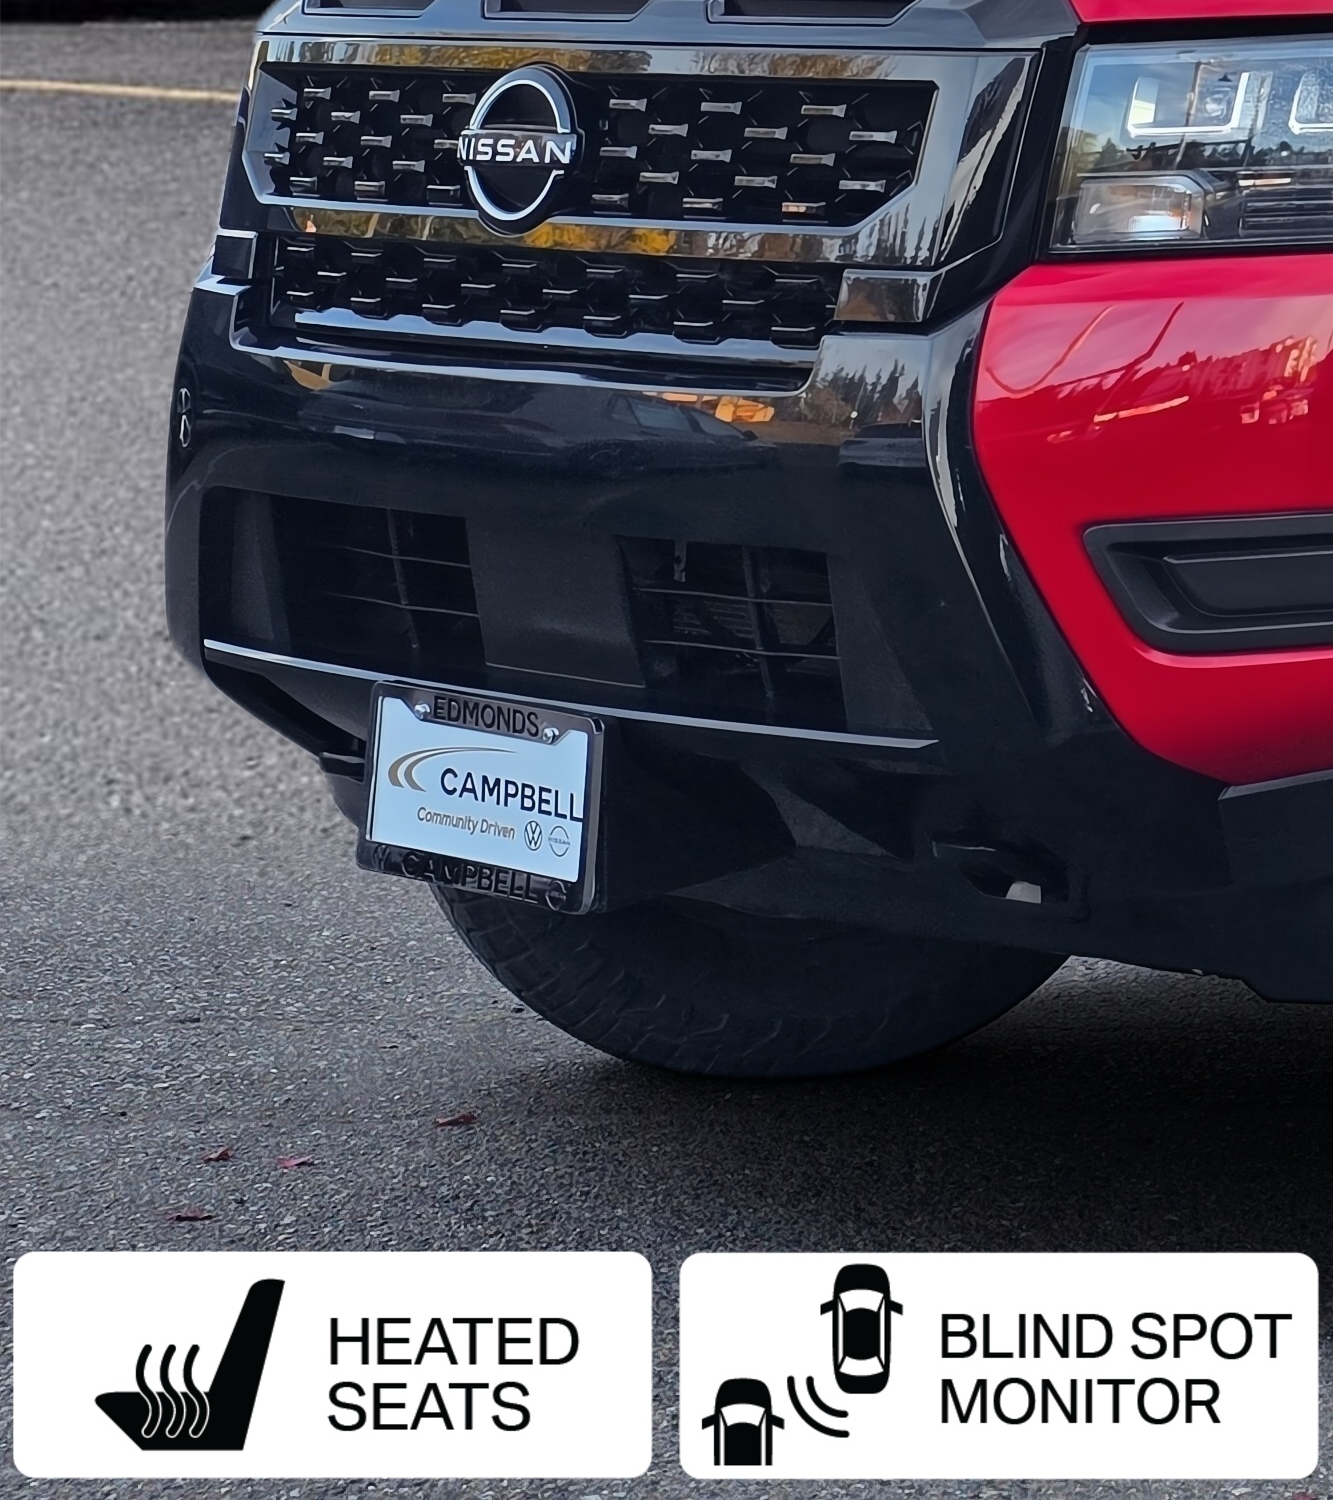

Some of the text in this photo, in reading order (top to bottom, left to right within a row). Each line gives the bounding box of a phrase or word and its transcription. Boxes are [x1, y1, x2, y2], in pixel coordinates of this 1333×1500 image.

[456, 135, 572, 164] NISSAN
[433, 695, 540, 738] EDMONDS
[440, 767, 584, 823] CAMPBELL
[417, 806, 516, 841] Community Driven
[401, 850, 539, 904] CAMPBELL
